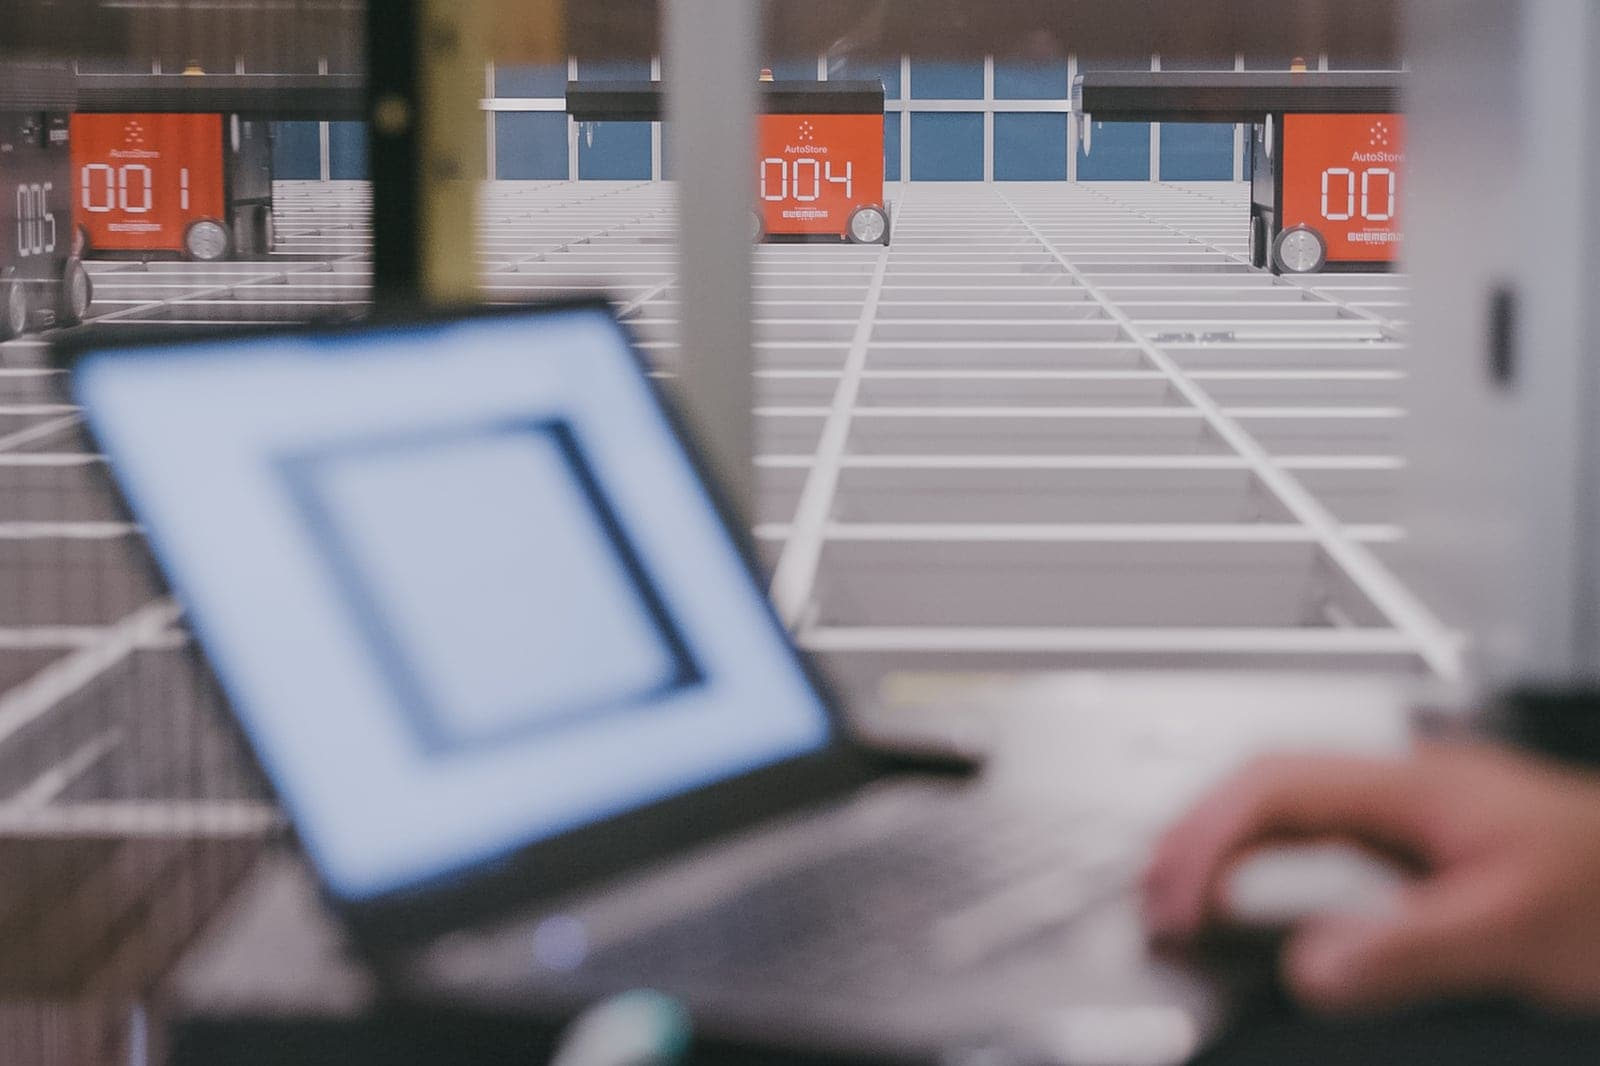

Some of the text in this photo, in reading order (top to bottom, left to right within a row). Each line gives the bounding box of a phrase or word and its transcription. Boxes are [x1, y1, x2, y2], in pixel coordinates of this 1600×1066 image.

[785, 145, 828, 154] AutoStore
[82, 164, 189, 213] 001
[761, 158, 852, 201] 004
[1321, 168, 1395, 221] 00
